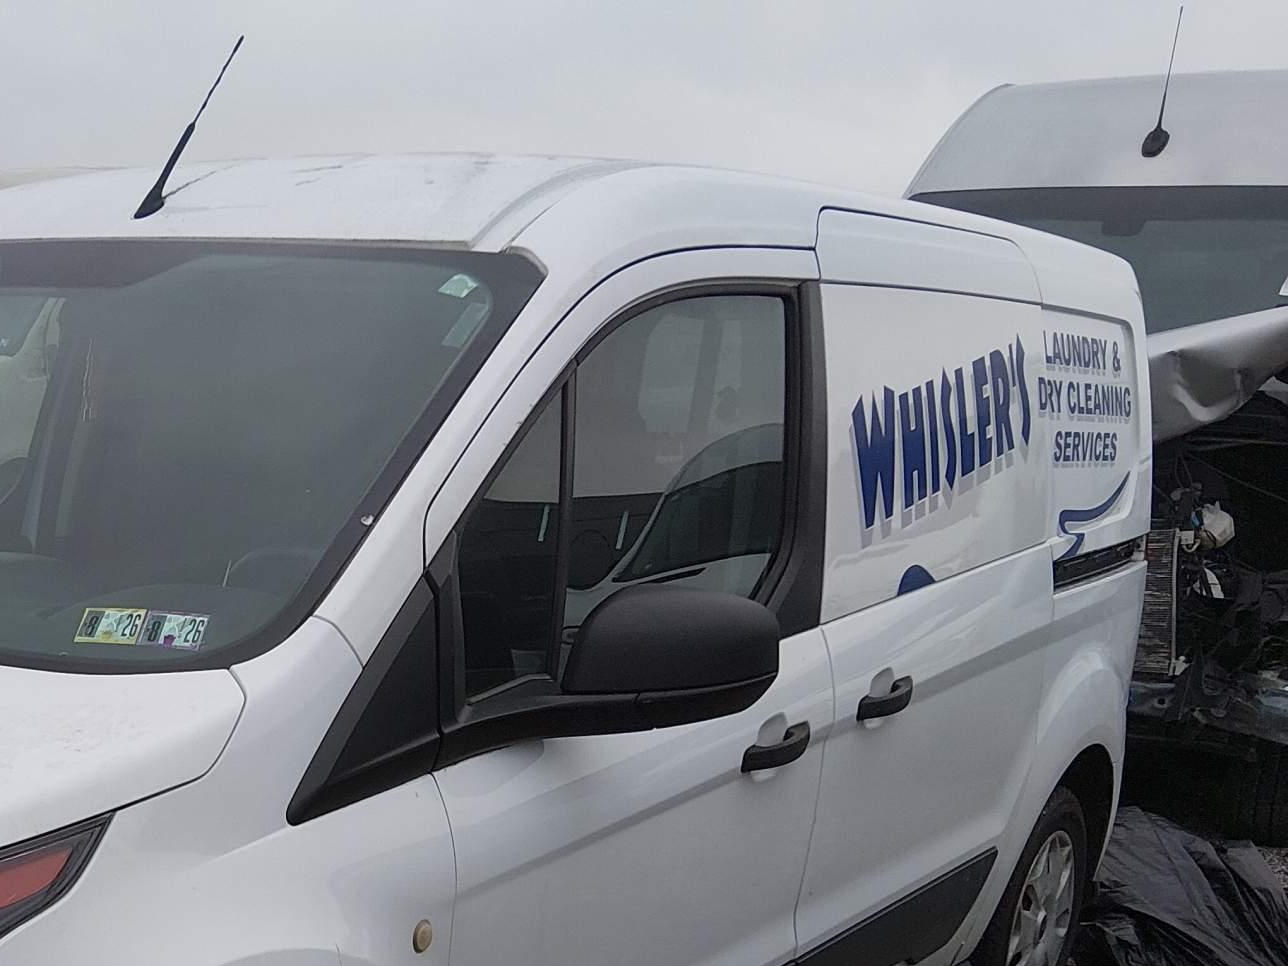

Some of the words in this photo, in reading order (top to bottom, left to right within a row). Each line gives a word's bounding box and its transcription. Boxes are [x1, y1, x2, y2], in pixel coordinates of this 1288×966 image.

[1043, 330, 1107, 370] LAUNDRY
[1112, 341, 1121, 372] &
[1038, 377, 1063, 413] DRY
[1067, 381, 1131, 417] CLEANING
[852, 333, 1031, 530] WHISLER'S
[1054, 430, 1117, 462] SERVICES
